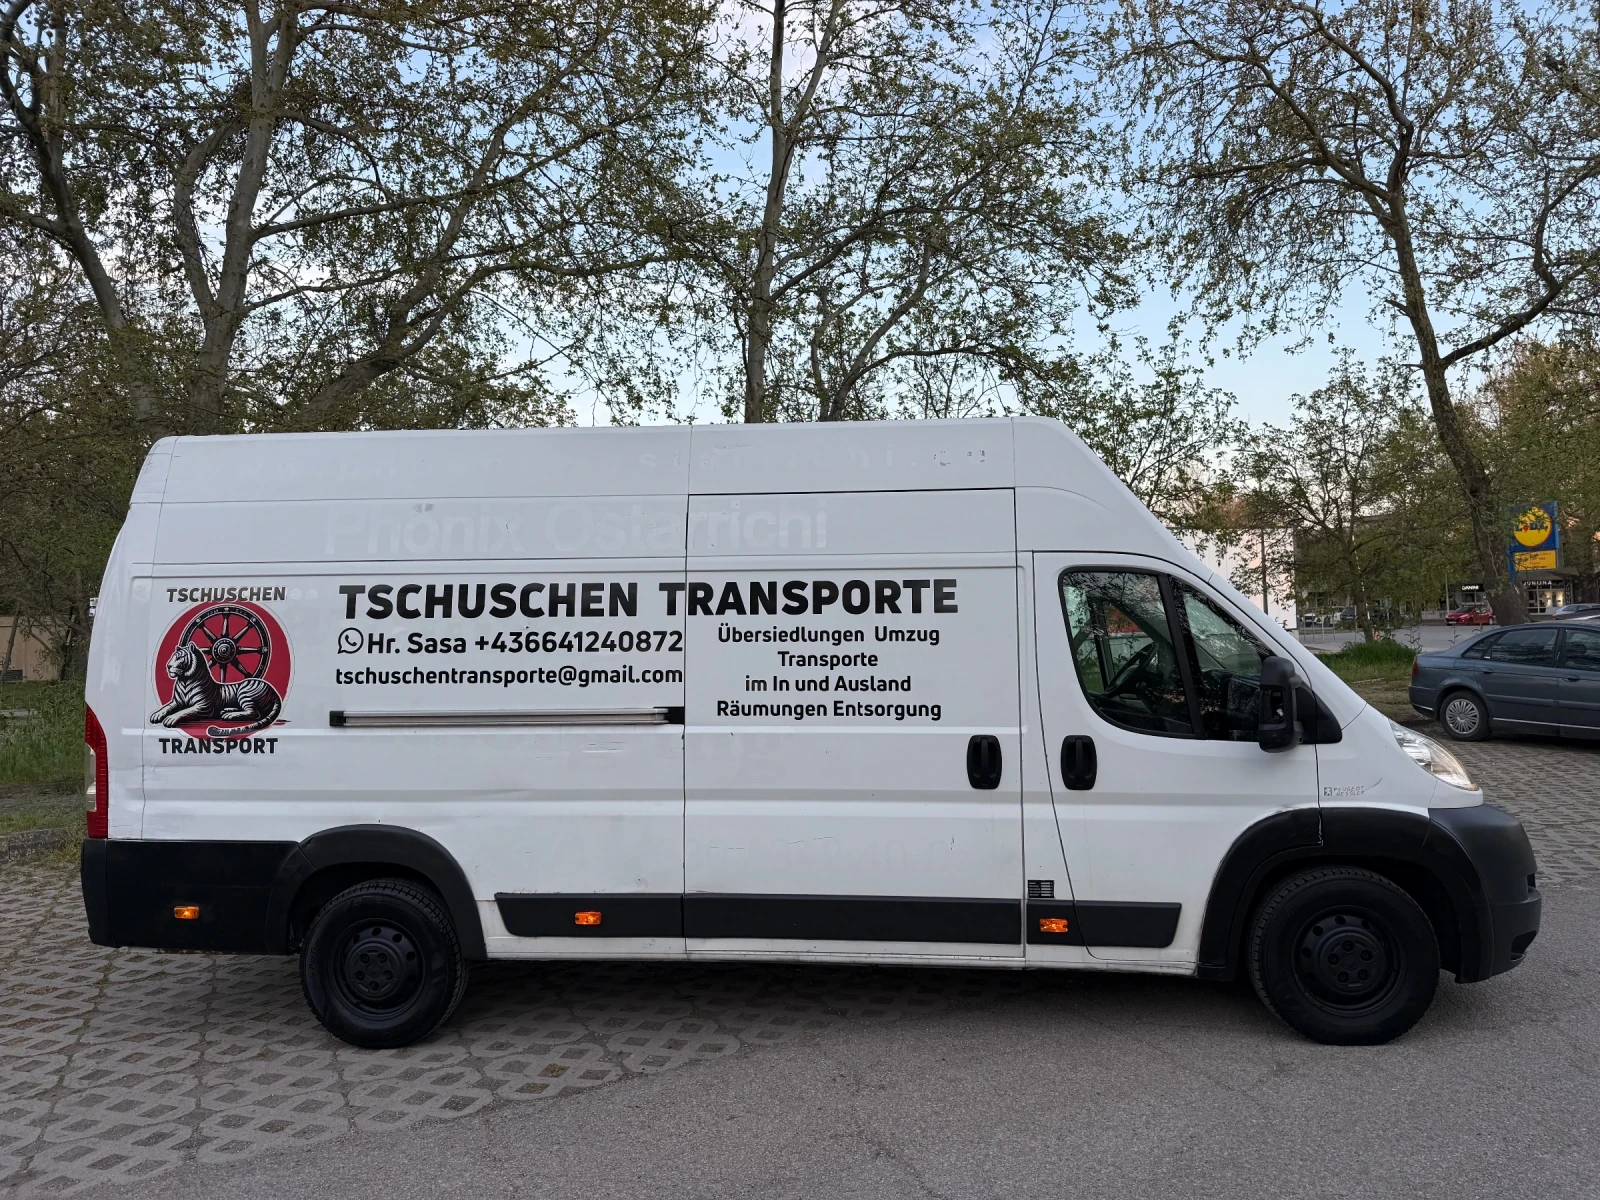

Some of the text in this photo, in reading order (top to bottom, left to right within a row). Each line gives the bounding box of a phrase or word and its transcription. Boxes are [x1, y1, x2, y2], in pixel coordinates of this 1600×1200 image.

[166, 586, 286, 603] TSCHUSCHEN
[339, 579, 959, 620] TSCHUSCHEN TRANSPORTE
[367, 630, 683, 655] Hr. Sasa +436641240872
[718, 622, 940, 647] Übersiedlungen Umzug
[778, 650, 879, 670] Transporte
[336, 664, 683, 688] tschuschentransporte@gmail.com
[745, 675, 912, 692] im In und Ausland
[717, 700, 942, 722] Räumungen Entsorgung
[159, 738, 278, 755] TRANSPORT
